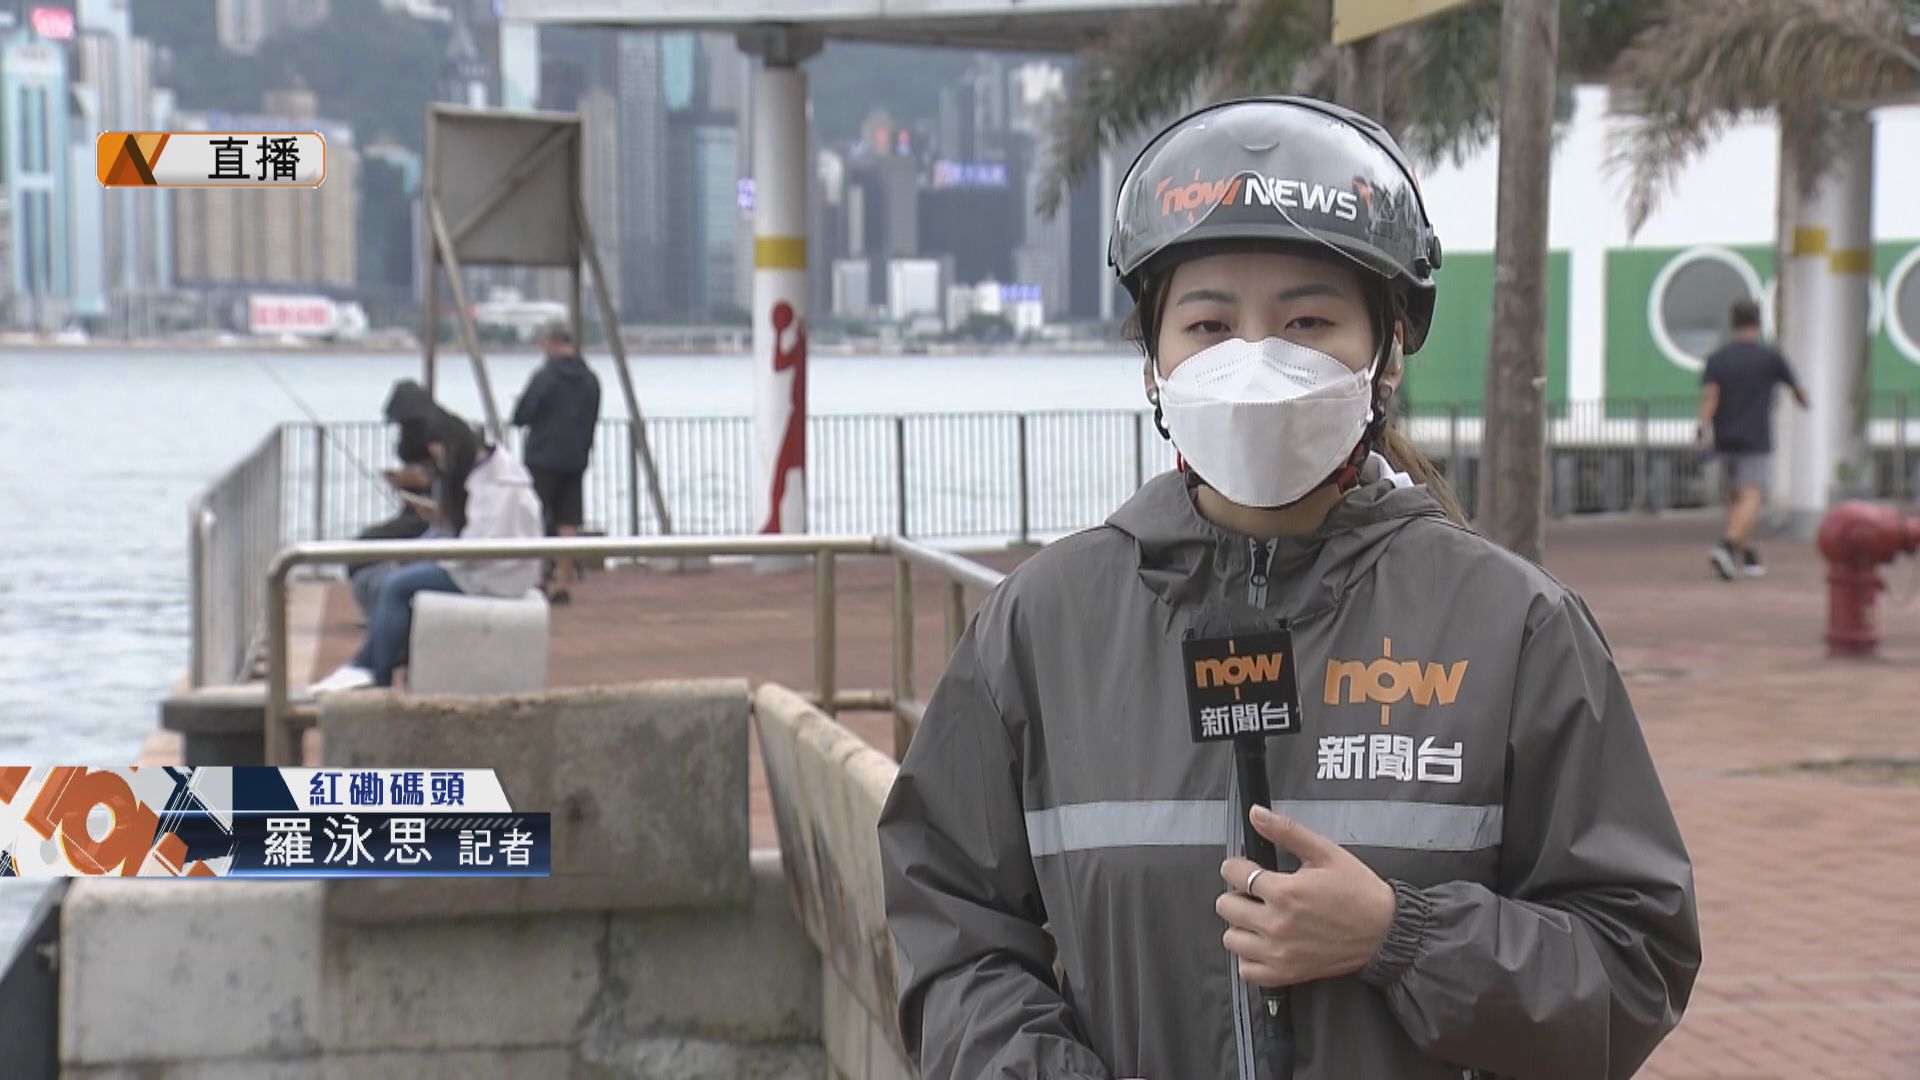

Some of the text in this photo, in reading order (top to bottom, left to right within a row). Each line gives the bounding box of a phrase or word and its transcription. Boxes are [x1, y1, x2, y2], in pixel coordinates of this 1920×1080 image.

[1161, 176, 1358, 221] now NEWS
[1195, 651, 1282, 690] now
[1323, 655, 1468, 707] now
[1200, 701, 1291, 737] 新聞台
[1316, 733, 1464, 783] 新聞台
